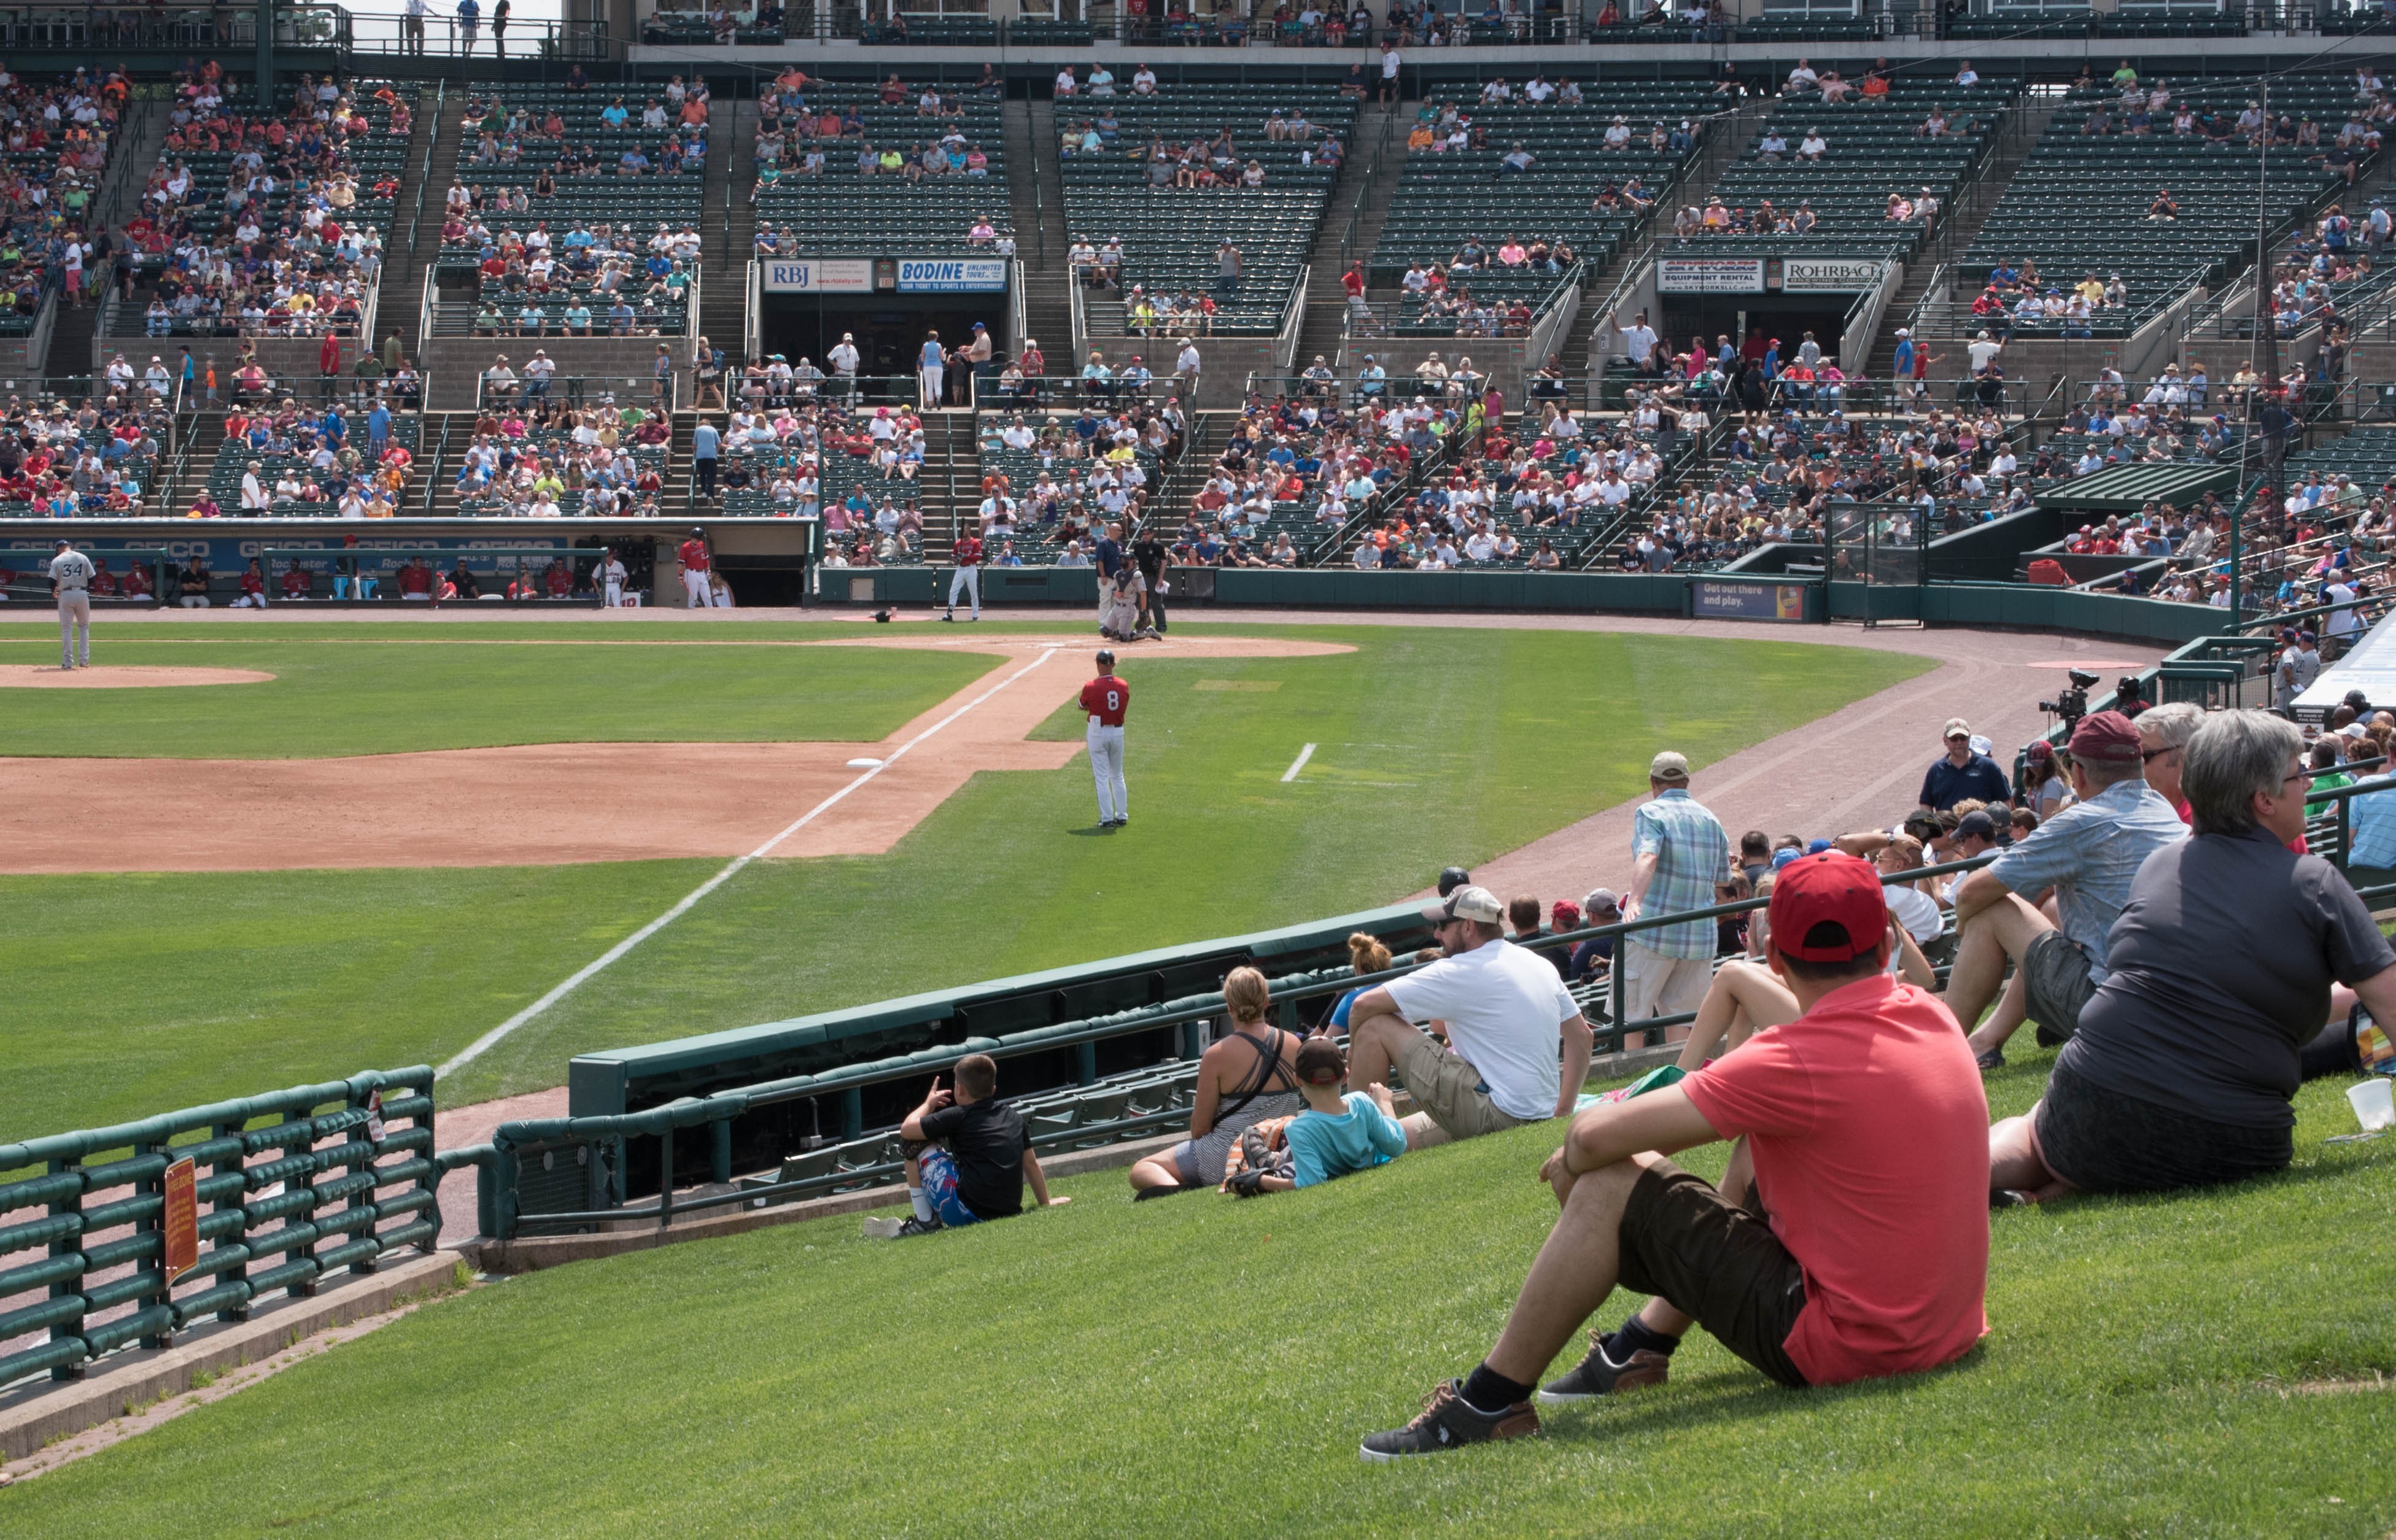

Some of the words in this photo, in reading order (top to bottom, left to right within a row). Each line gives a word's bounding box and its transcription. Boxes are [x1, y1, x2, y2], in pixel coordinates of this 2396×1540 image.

[773, 266, 809, 288] RBJ
[902, 263, 964, 280] BODINE
[1790, 265, 1883, 278] ROHRBACH
[63, 563, 83, 577] 34
[1704, 583, 1720, 593] Get
[1721, 584, 1737, 594] out
[1738, 584, 1762, 595] there
[1704, 595, 1720, 605] and
[1722, 595, 1743, 608] play.
[1107, 691, 1119, 711] 8
[179, 1172, 192, 1188] ZONE
